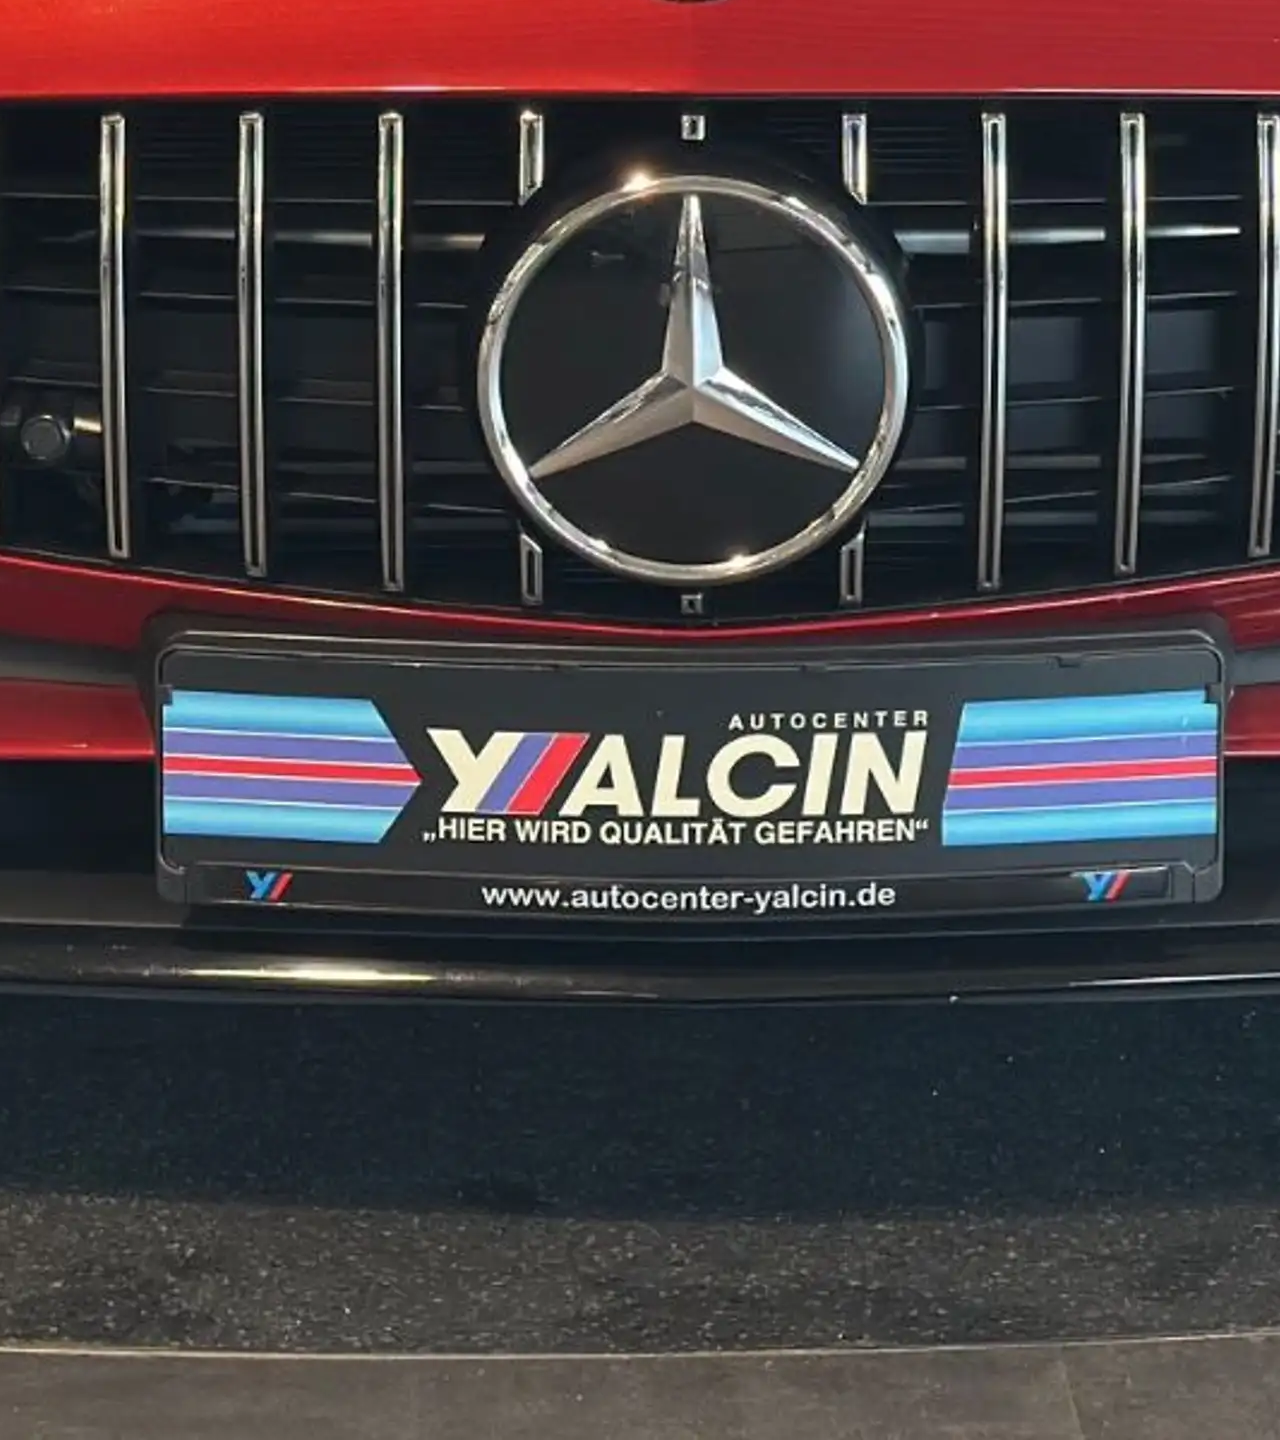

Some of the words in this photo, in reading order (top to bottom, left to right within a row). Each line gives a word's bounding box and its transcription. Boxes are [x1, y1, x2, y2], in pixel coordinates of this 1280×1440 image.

[728, 710, 929, 731] AUTOCENTER
[426, 728, 928, 818] YALCIN
[514, 820, 592, 844] WIRD
[599, 817, 747, 846] QUALITÄT
[481, 881, 896, 914] www.autocenter-yalcin.de
